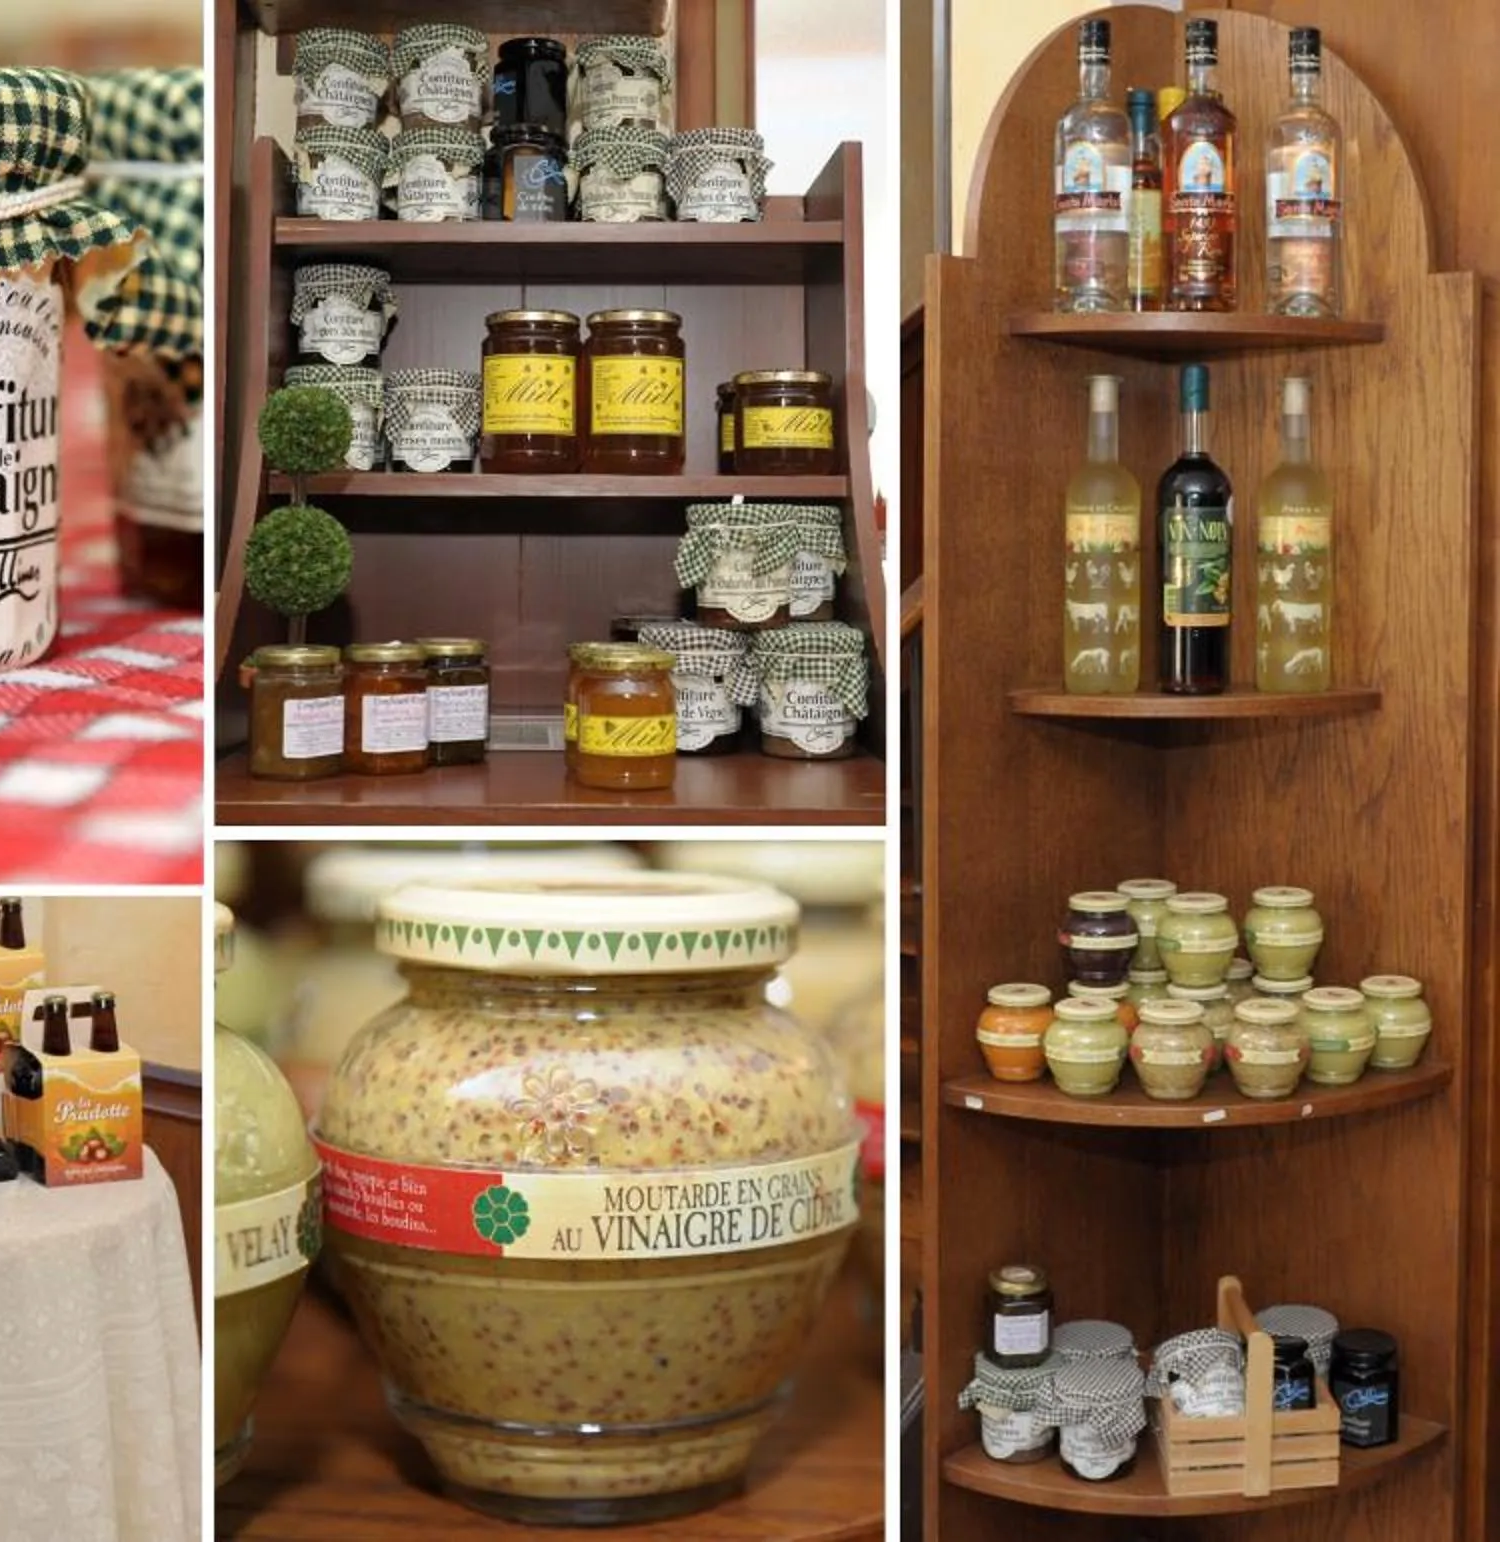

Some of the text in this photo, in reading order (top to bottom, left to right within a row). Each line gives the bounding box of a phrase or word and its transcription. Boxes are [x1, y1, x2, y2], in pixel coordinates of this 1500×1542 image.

[604, 1166, 824, 1214] MOUTARDE EN GRAINS
[225, 1214, 292, 1272] VELAY
[551, 1187, 846, 1252] AU VINAIGRE DE CIDRE
